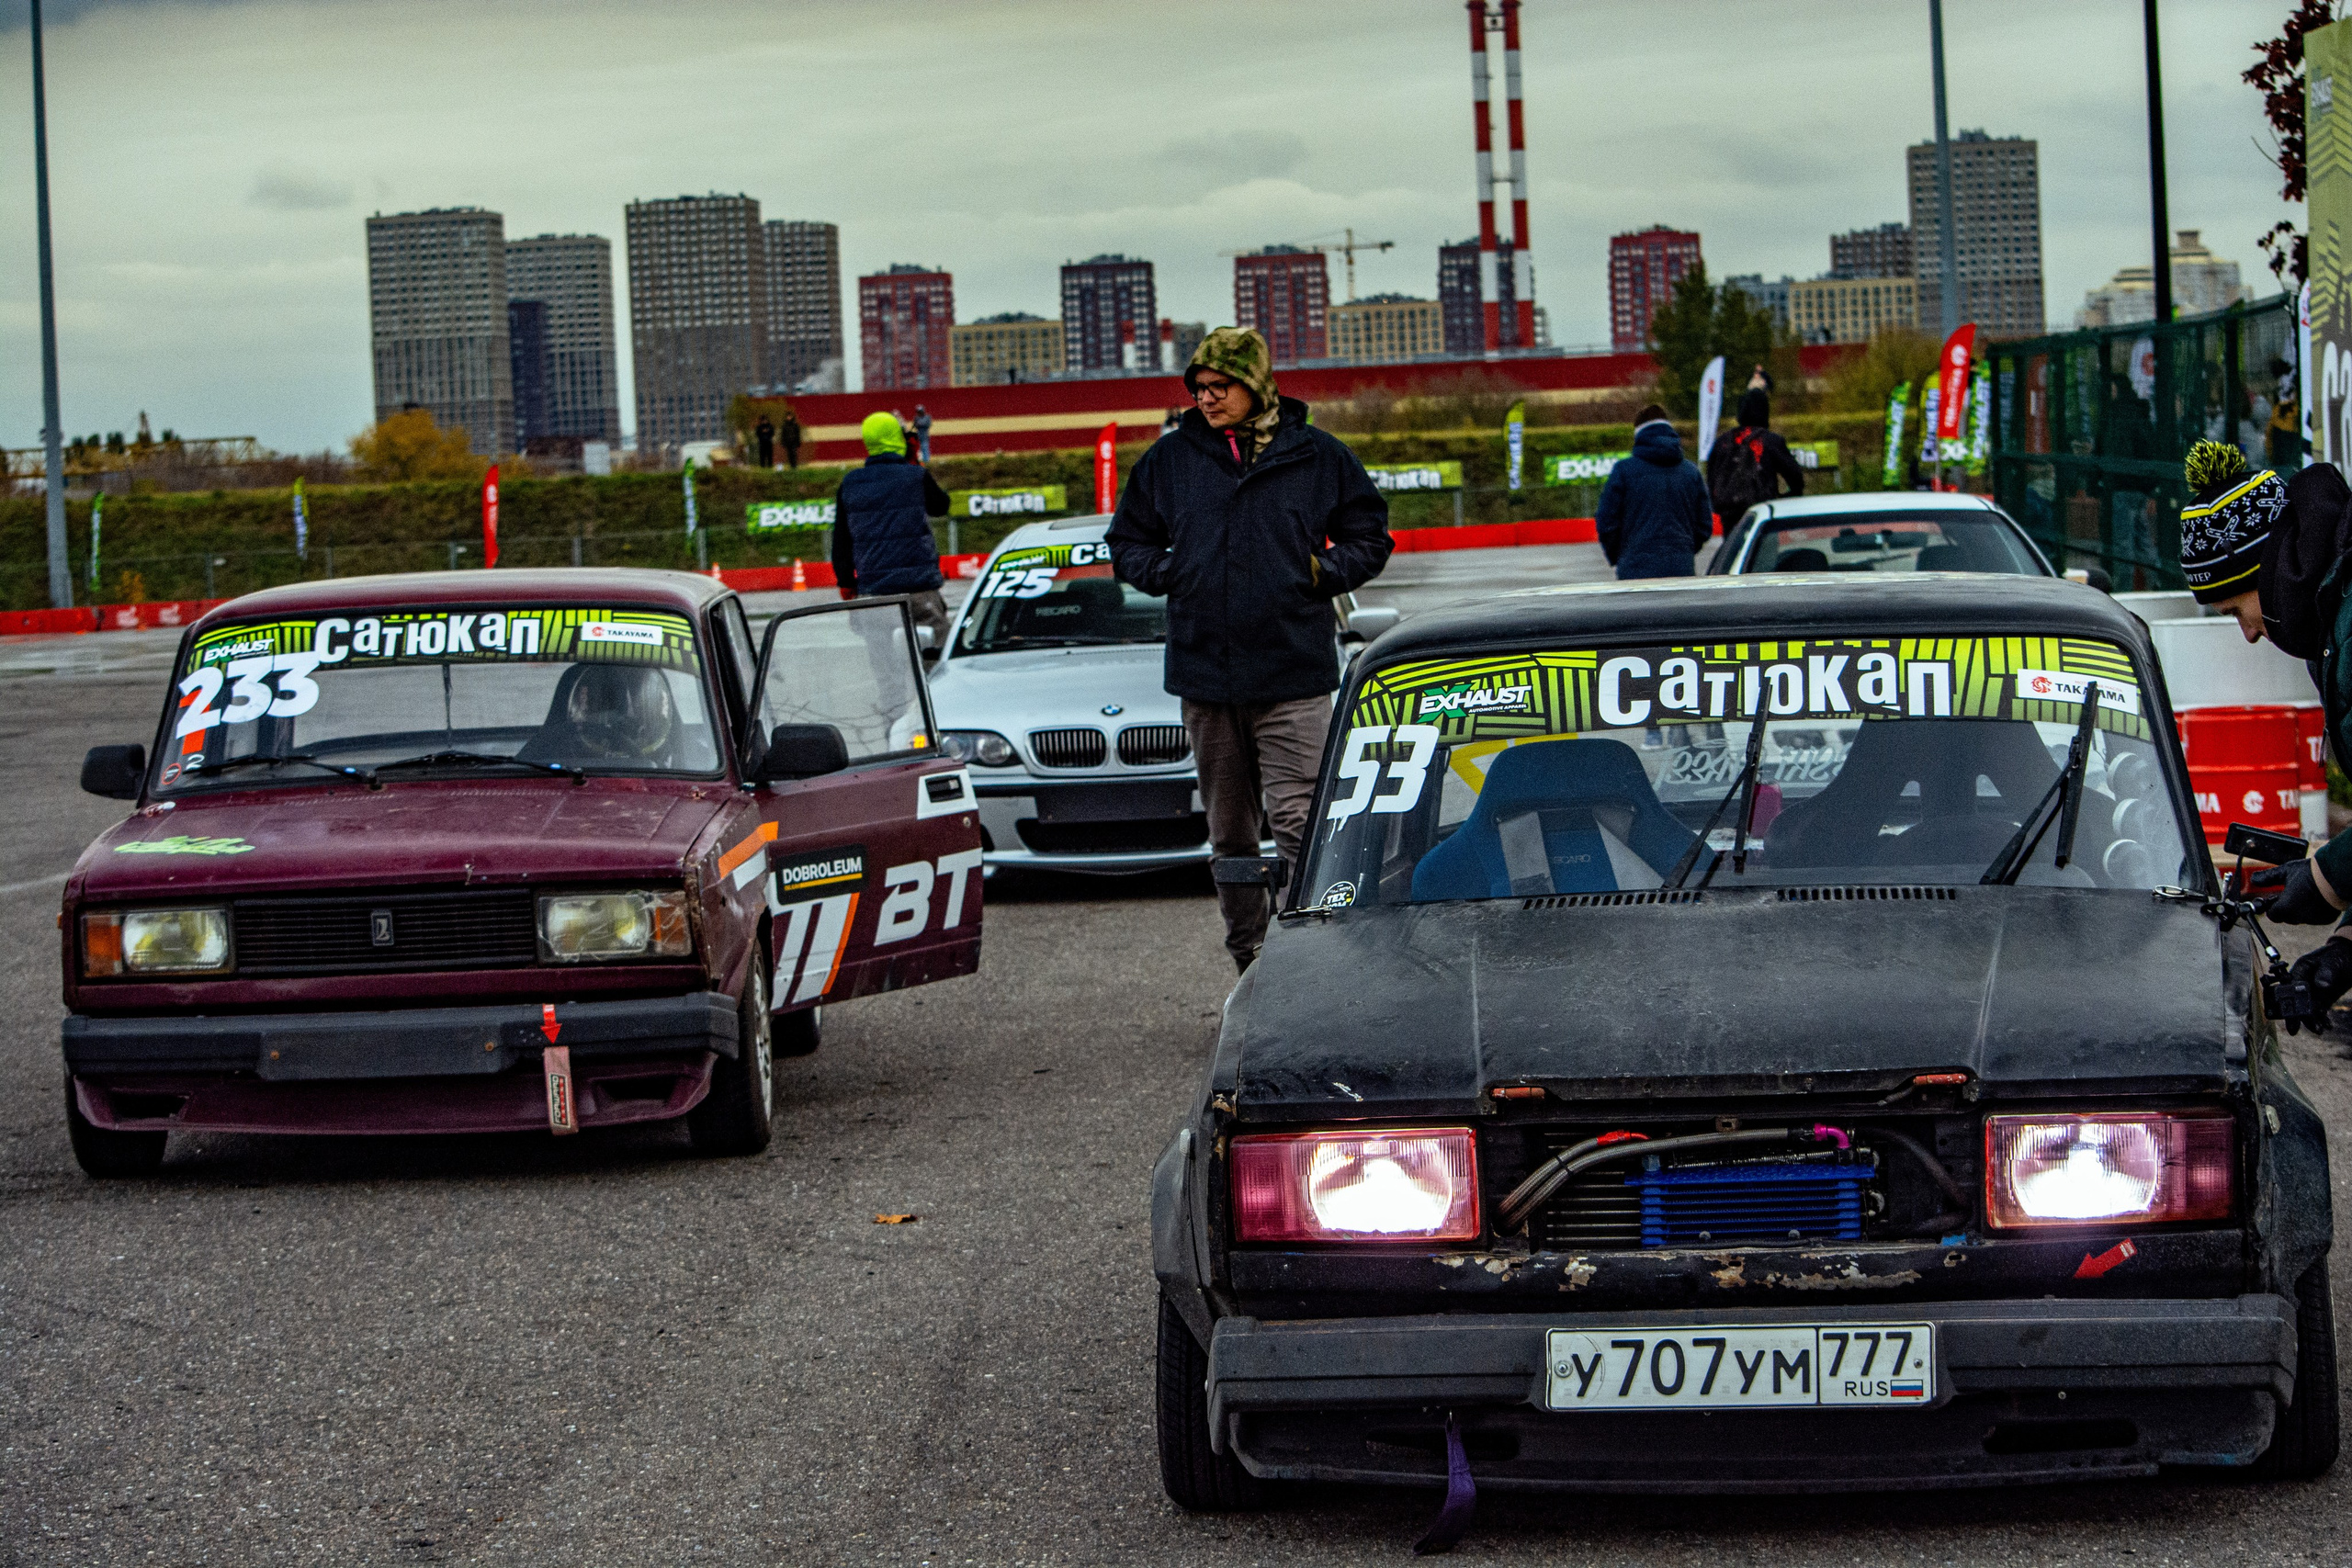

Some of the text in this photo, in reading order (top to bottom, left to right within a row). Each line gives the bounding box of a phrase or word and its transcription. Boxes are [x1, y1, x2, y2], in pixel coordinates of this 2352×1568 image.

[759, 503, 837, 527] EXHAUS
[980, 568, 1059, 599] 125
[606, 629, 654, 639] TAKAYAMA
[203, 638, 275, 662] EXHAUST
[175, 651, 320, 740] 233
[1419, 685, 1532, 715] EXHAUST
[2055, 682, 2126, 704] TAKAAMA
[1326, 724, 1440, 824] 53
[783, 856, 863, 885] DOBROLEUM
[1571, 1331, 1912, 1398] У707УМ 777
[1845, 1380, 1888, 1397] RUS
